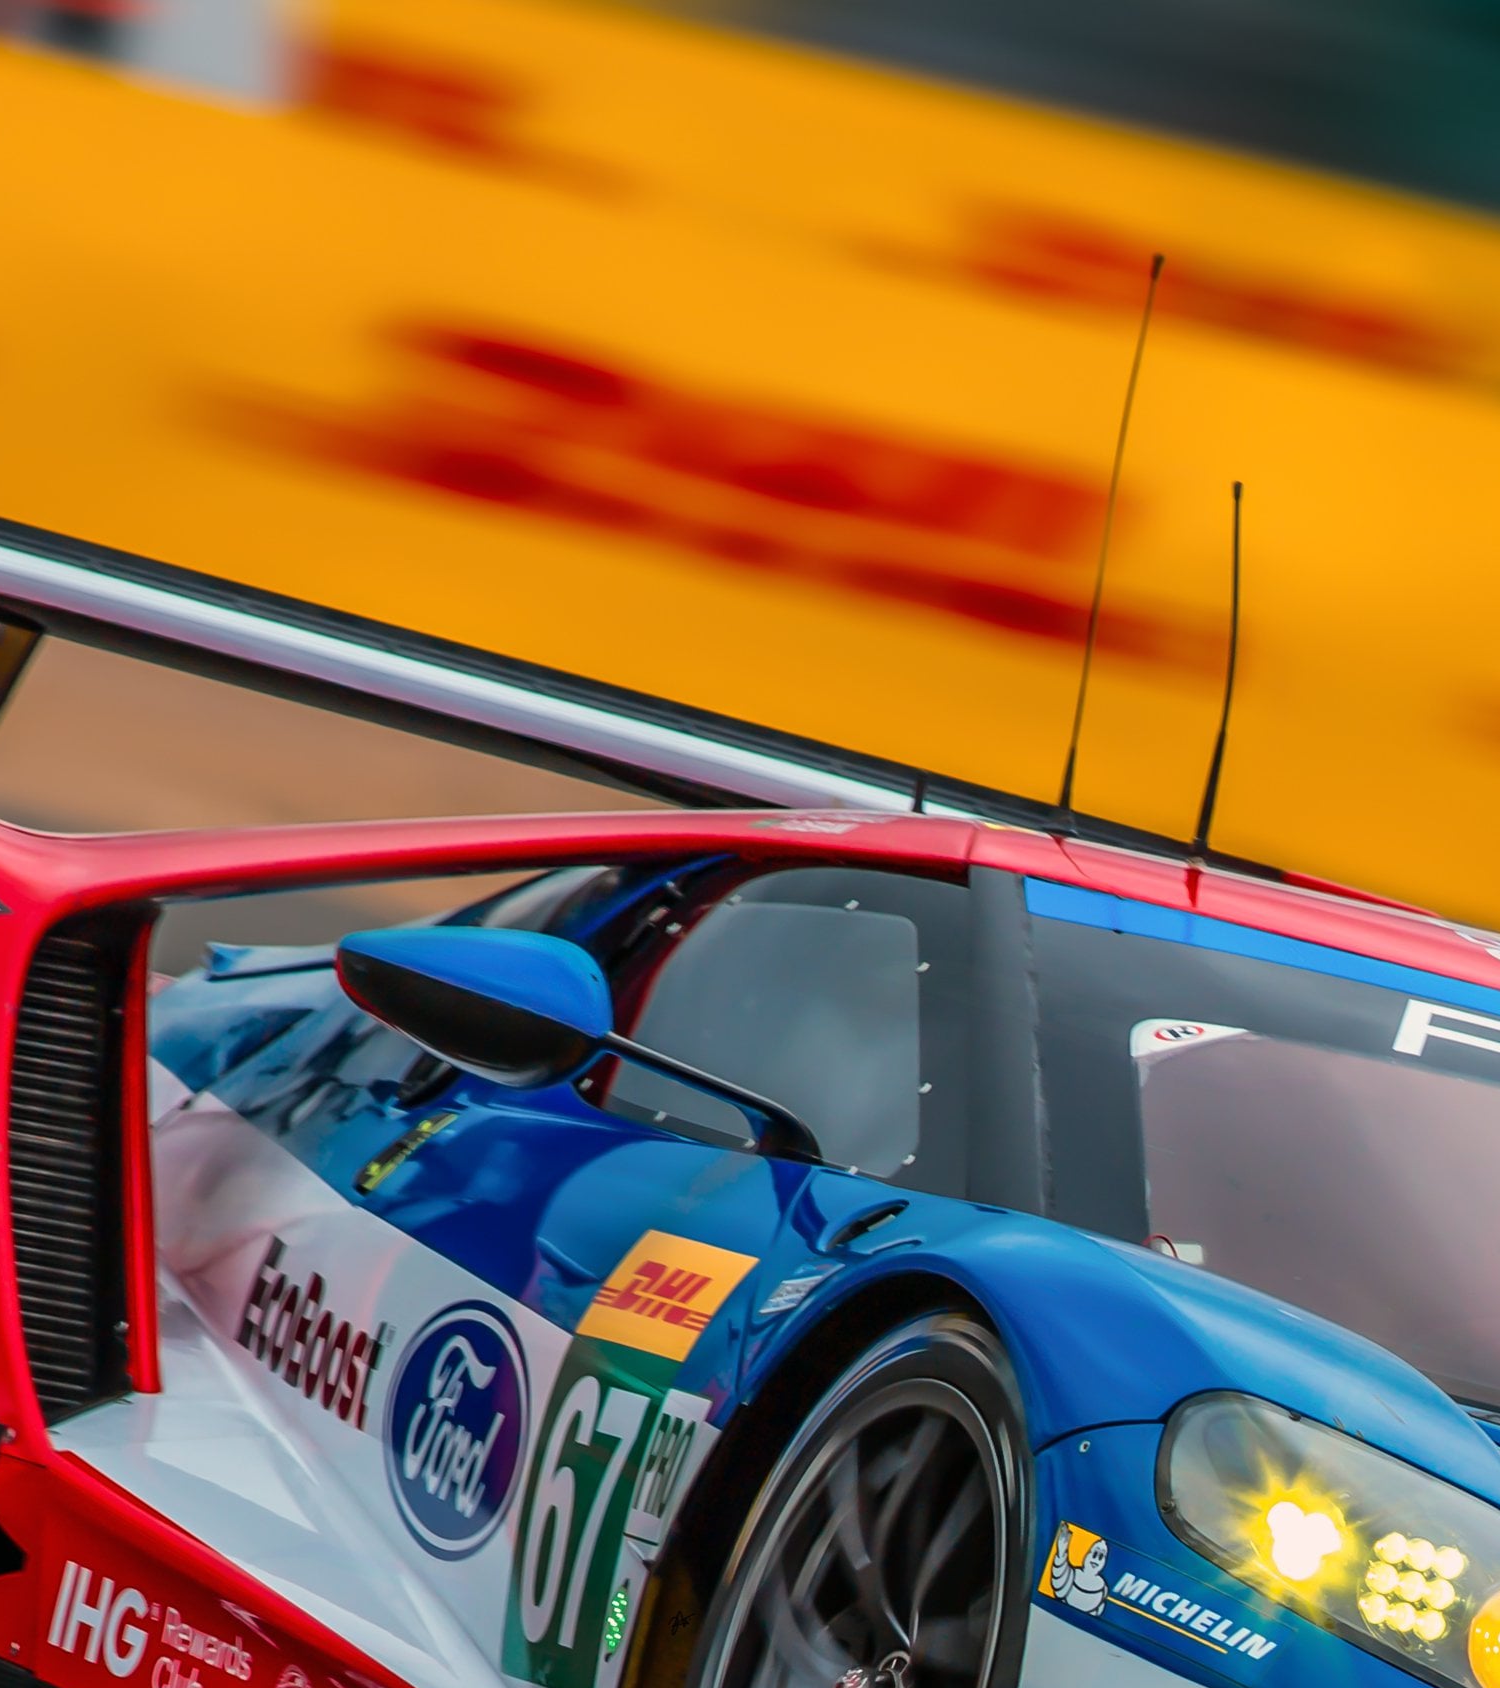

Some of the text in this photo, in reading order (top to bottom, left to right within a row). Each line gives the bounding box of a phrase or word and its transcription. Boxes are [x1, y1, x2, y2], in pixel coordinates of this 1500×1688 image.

[597, 1260, 713, 1331] DHL
[404, 1334, 506, 1519] Ford
[631, 1412, 697, 1520] PRO
[520, 1375, 651, 1650] 67
[47, 1559, 150, 1679] IHG
[160, 1606, 253, 1682] Rewards
[1112, 1572, 1278, 1660] MICHELIN
